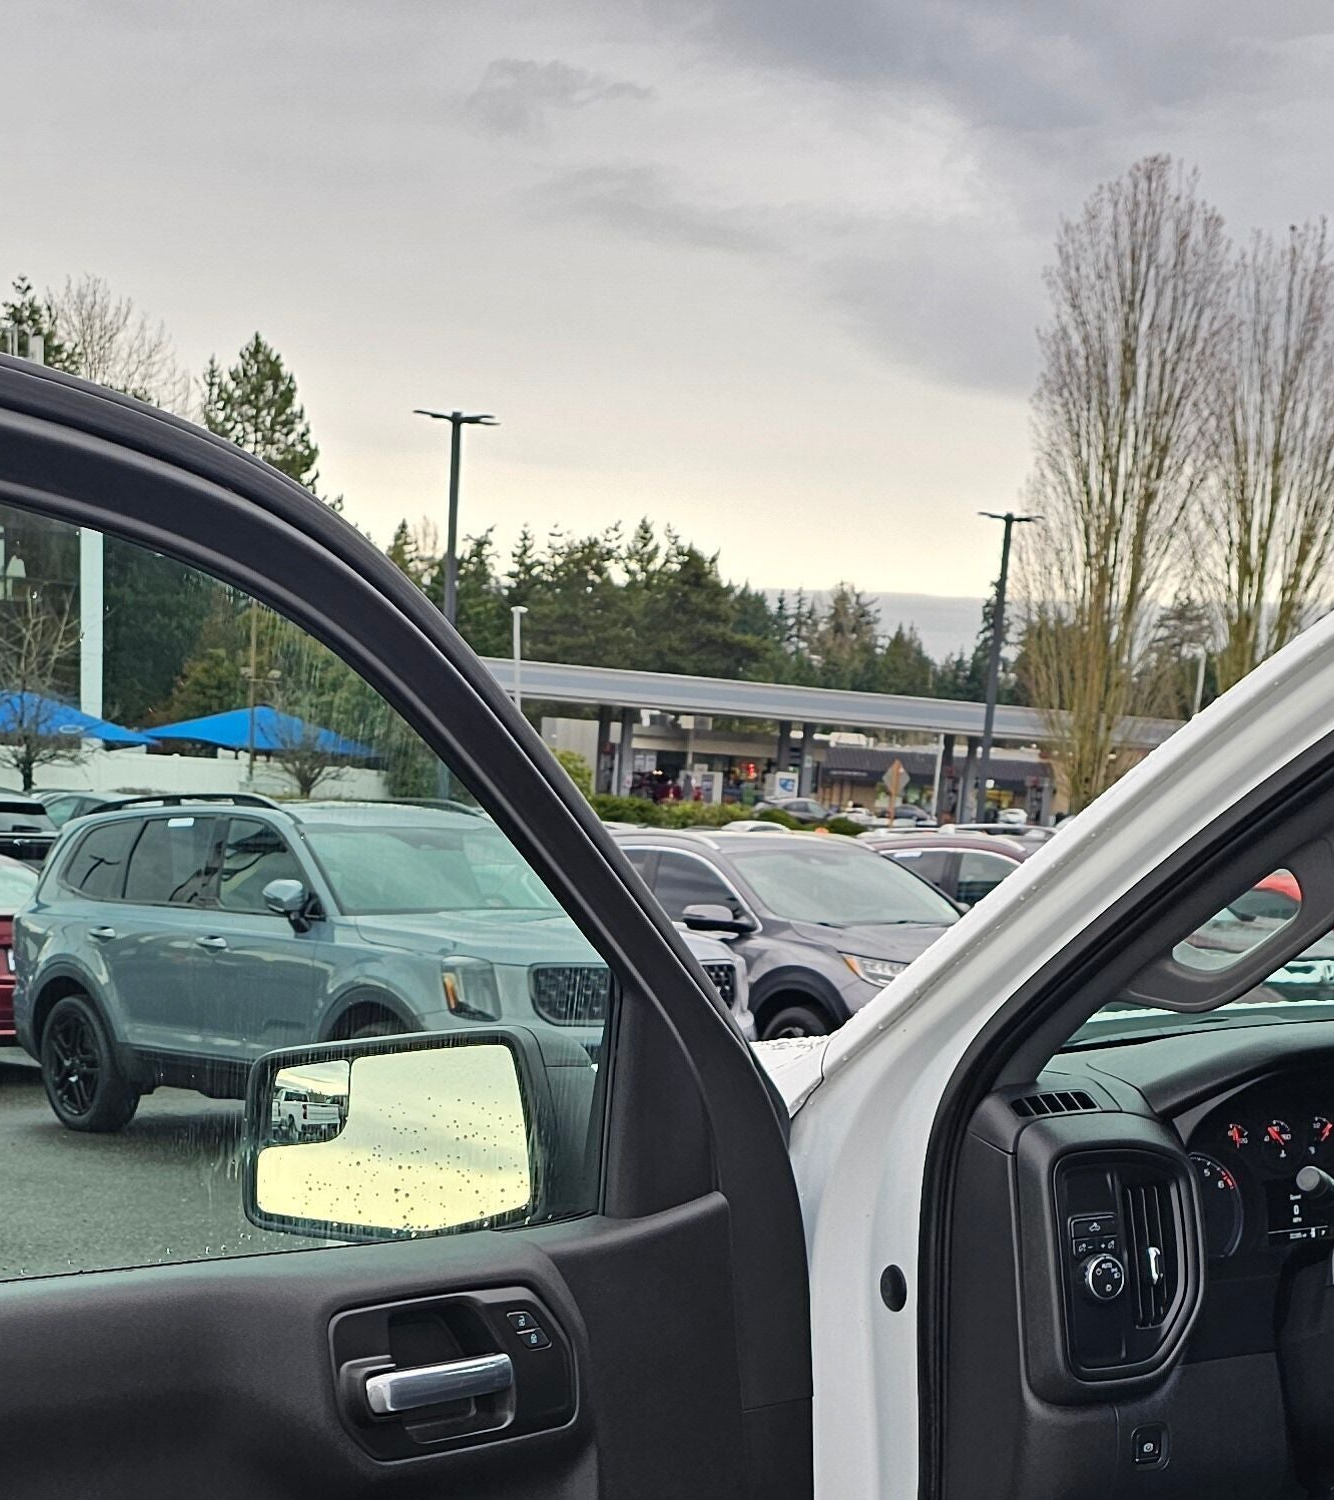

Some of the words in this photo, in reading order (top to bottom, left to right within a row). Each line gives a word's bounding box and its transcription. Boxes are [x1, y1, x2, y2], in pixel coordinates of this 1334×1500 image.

[1204, 1169, 1210, 1177] 5
[1218, 1180, 1224, 1188] 6
[1293, 1204, 1299, 1215] 0
